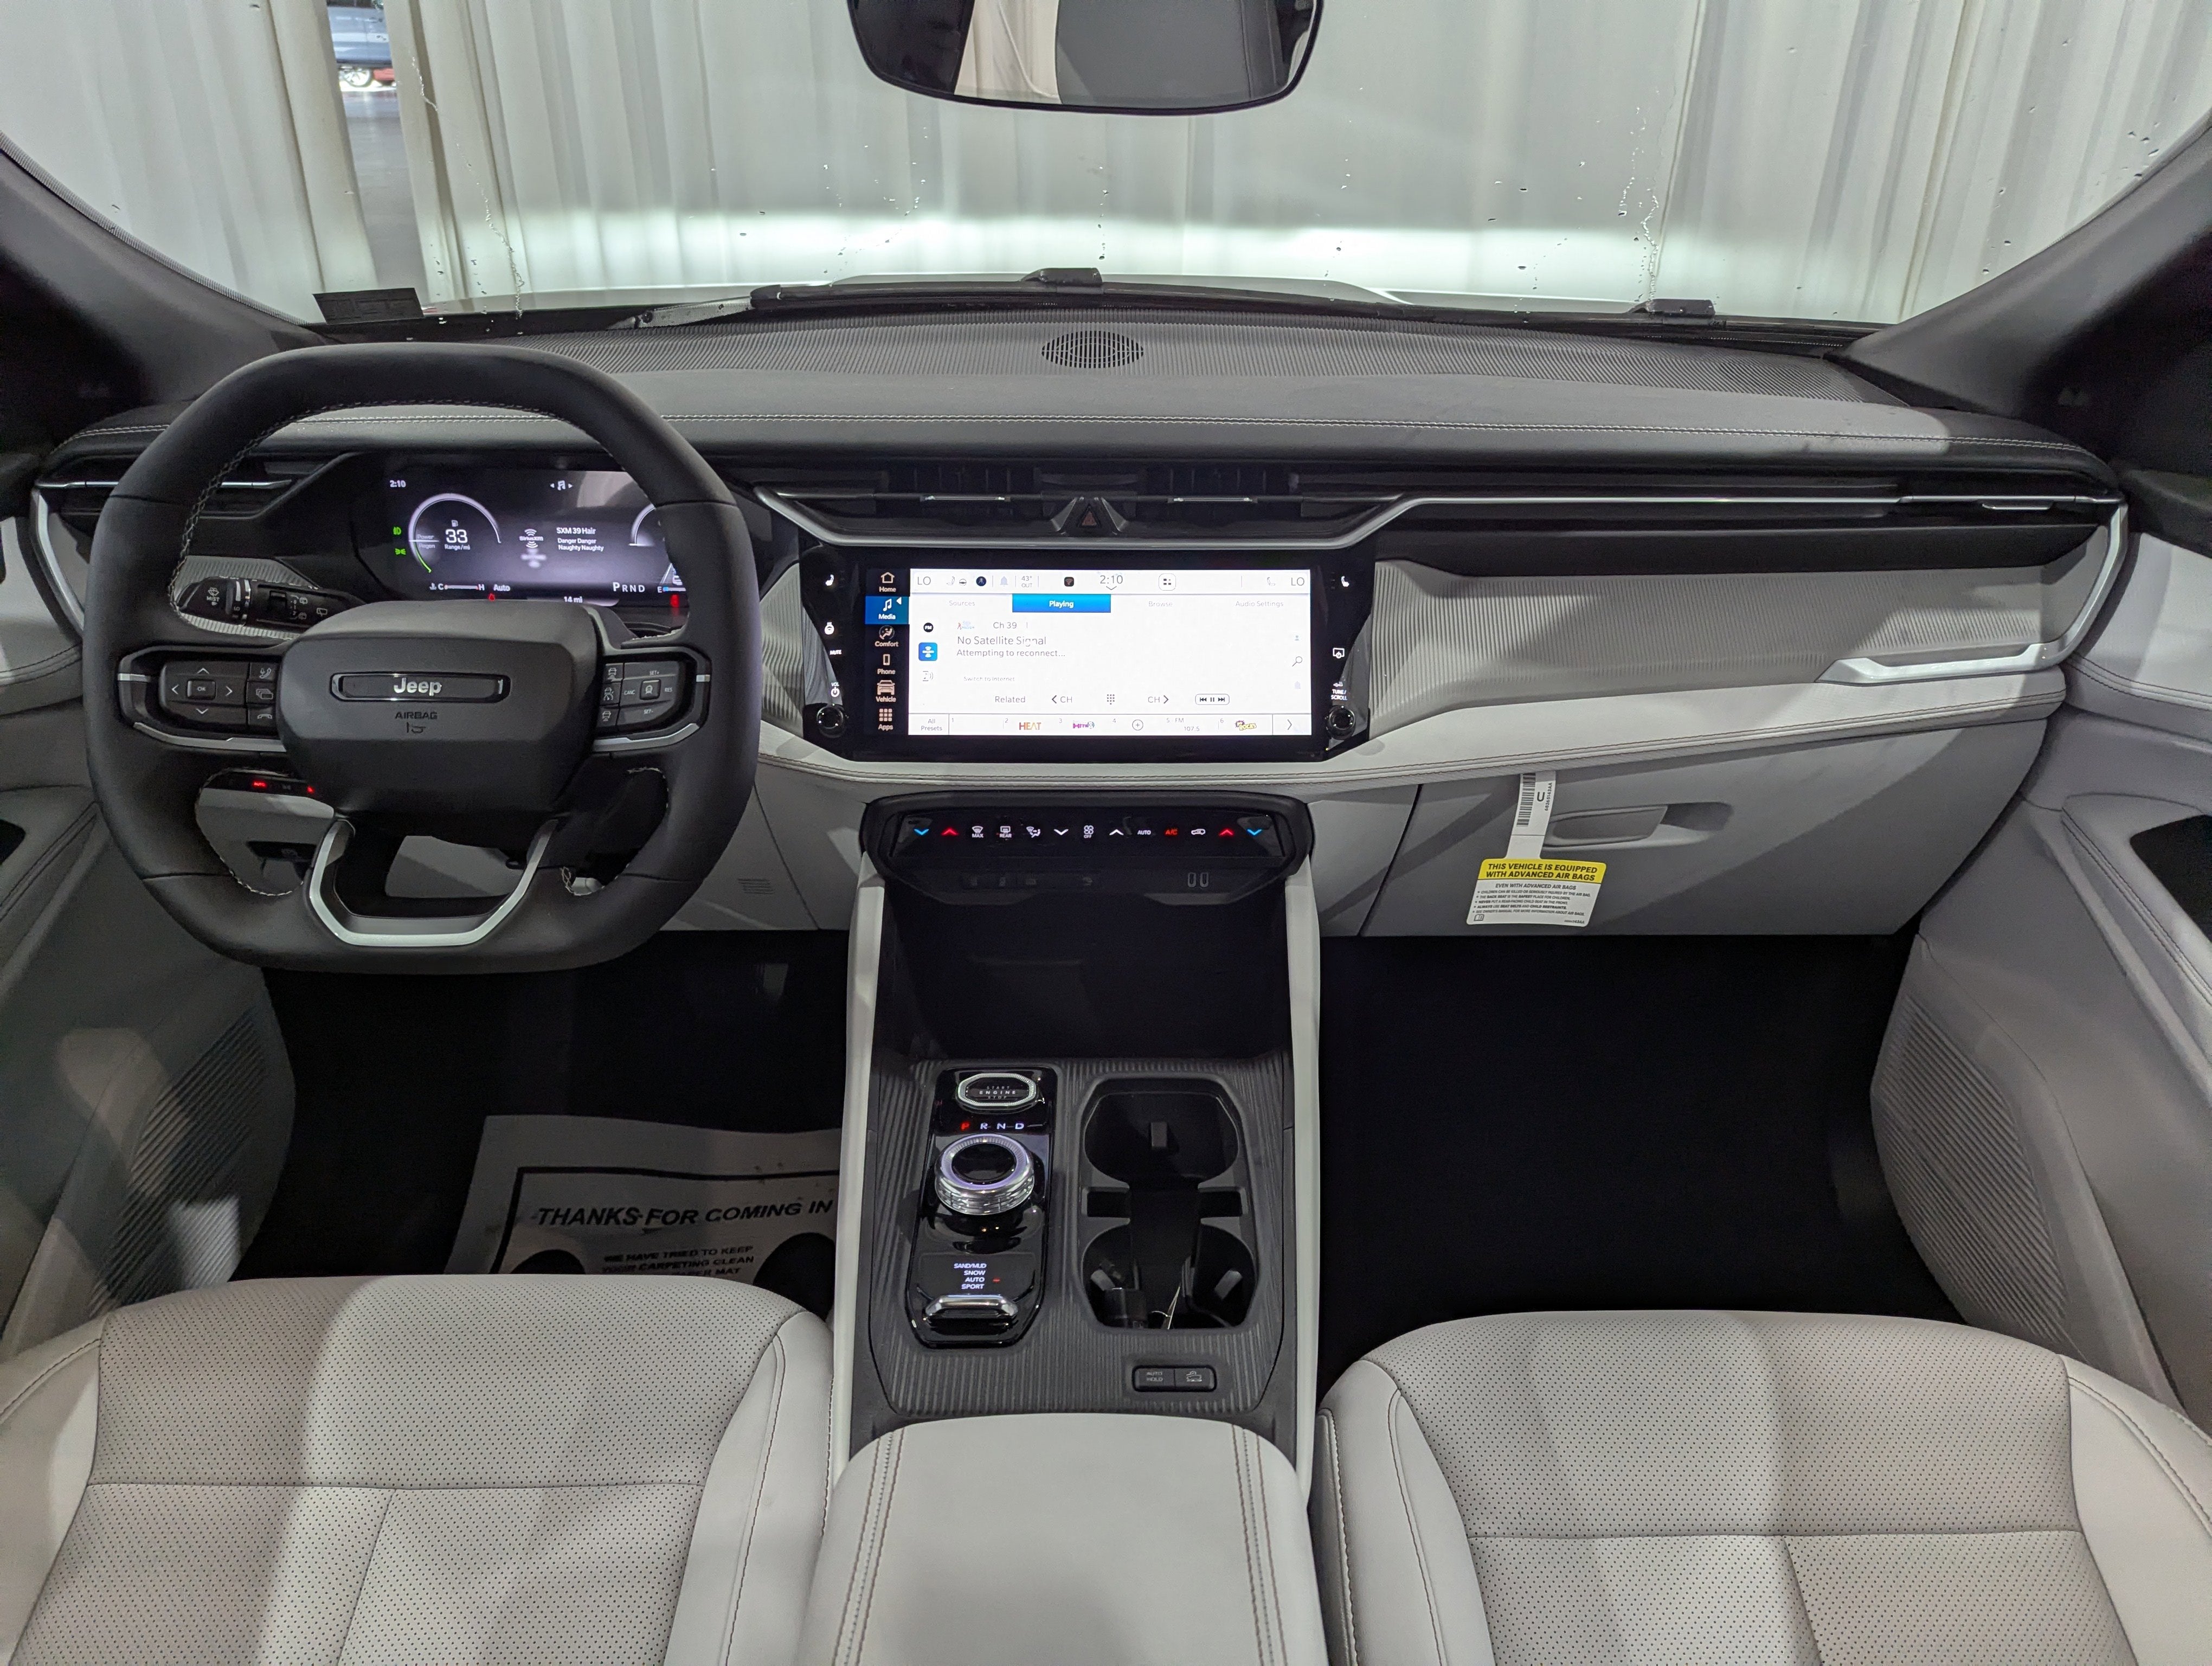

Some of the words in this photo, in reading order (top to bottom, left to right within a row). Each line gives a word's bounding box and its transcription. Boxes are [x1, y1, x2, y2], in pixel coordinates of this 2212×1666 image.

[445, 529, 468, 543] 33
[917, 576, 931, 586] LO
[1100, 575, 1123, 584] 2:10
[1290, 577, 1305, 586] LO
[1049, 600, 1074, 608] Playing
[957, 636, 971, 645] No
[974, 636, 1013, 645] Satellite
[1016, 636, 1046, 646] Signal
[956, 649, 1004, 658] Attempting
[393, 677, 442, 696] Jeep
[395, 712, 438, 720] AIRBAG
[1019, 722, 1041, 731] HEAT
[1537, 792, 1545, 802] U
[1554, 864, 1598, 873] EQUIPPED
[1572, 873, 1596, 881] BAGS
[538, 1207, 640, 1226] THANKS
[644, 1208, 699, 1226] FOR
[705, 1203, 802, 1222] COMING
[808, 1200, 833, 1214] IN
[721, 1246, 754, 1254] KEEP
[713, 1256, 754, 1265] CLEAN
